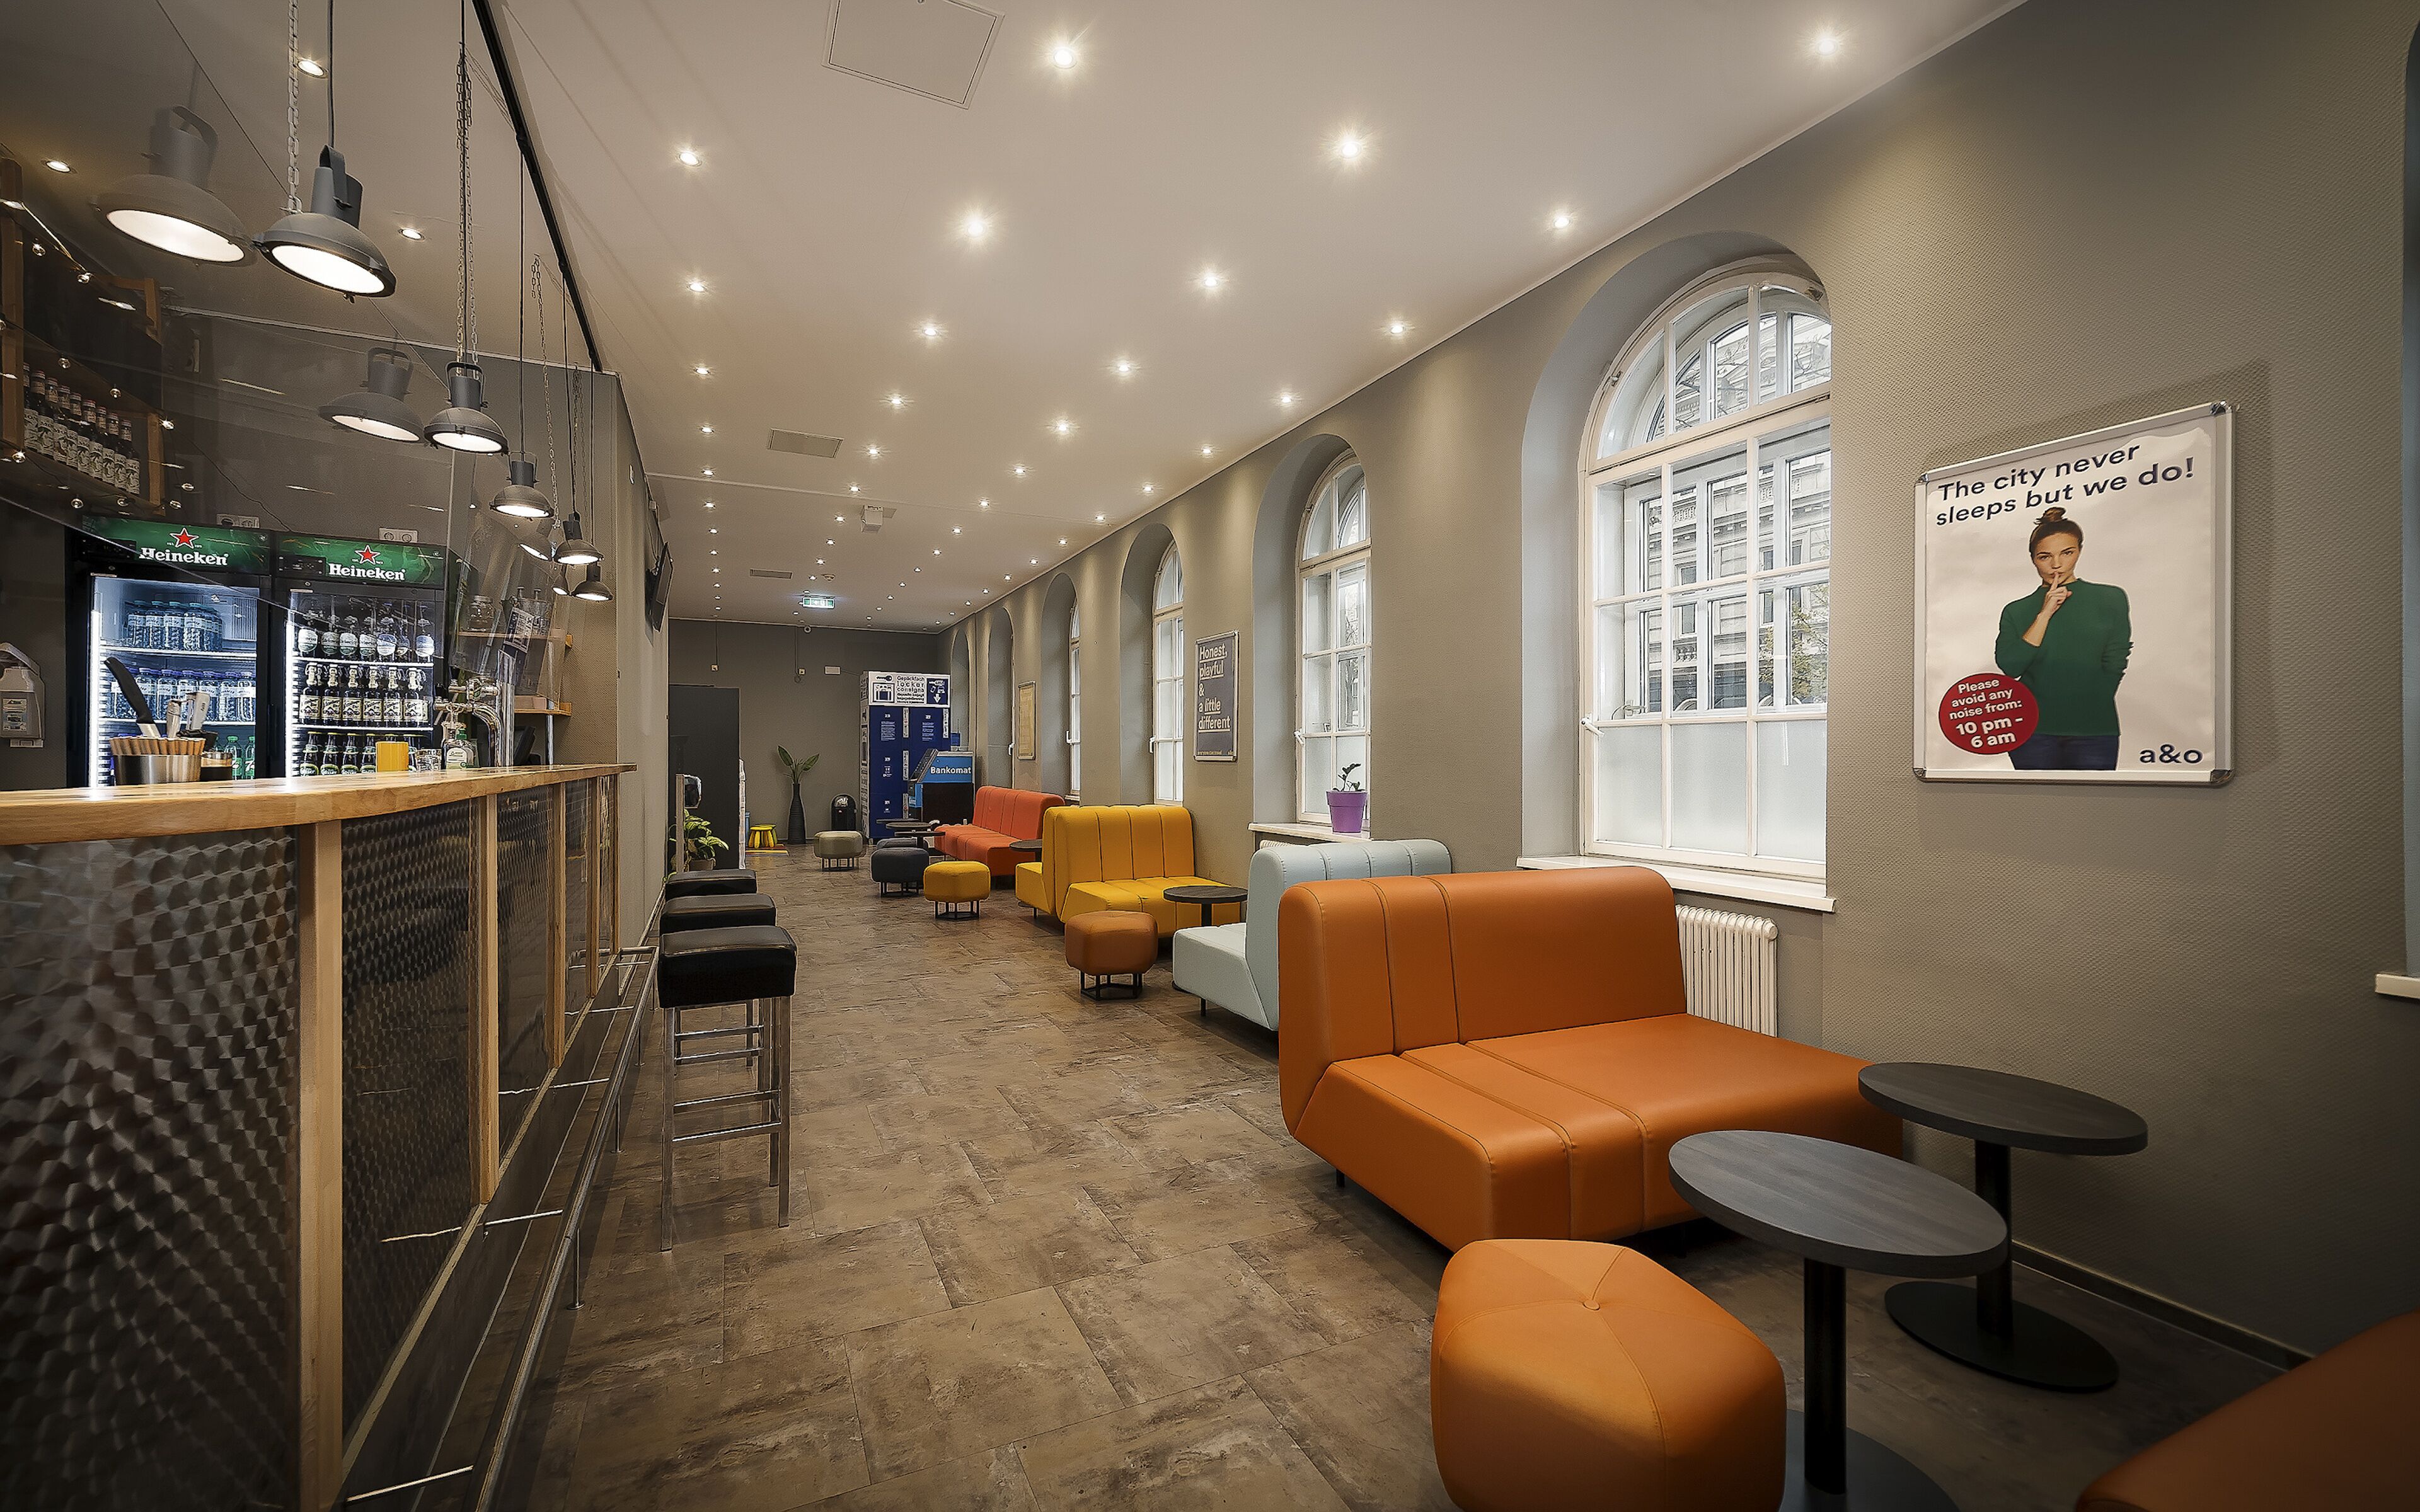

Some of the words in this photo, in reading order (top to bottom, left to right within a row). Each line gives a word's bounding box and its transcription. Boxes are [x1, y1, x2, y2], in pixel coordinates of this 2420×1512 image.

[1937, 481, 1986, 501] The
[1994, 467, 2047, 490] city
[2055, 445, 2140, 477] never
[1937, 500, 2017, 525] sleeps
[2025, 484, 2073, 508] but
[2083, 476, 2128, 496] we
[2138, 457, 2194, 485] do!
[139, 547, 228, 566] Heineken
[328, 563, 405, 581] Heineken
[1199, 643, 1228, 660] Honest,
[1199, 660, 1224, 680] playful
[1199, 683, 1205, 696] &
[1958, 679, 2000, 694] Please
[1199, 702, 1203, 713] a
[1204, 697, 1221, 712] little
[1951, 692, 1986, 707] avoid
[1989, 689, 2013, 699] any
[1949, 707, 1983, 719] noise
[1985, 700, 2022, 713] from:
[1199, 716, 1230, 730] different
[1956, 721, 1978, 735] 10
[1981, 717, 2012, 734] pm
[1971, 735, 1983, 748] 6
[1987, 732, 2016, 746] am
[2140, 743, 2203, 764] a&o
[930, 766, 971, 774] Bankomat
